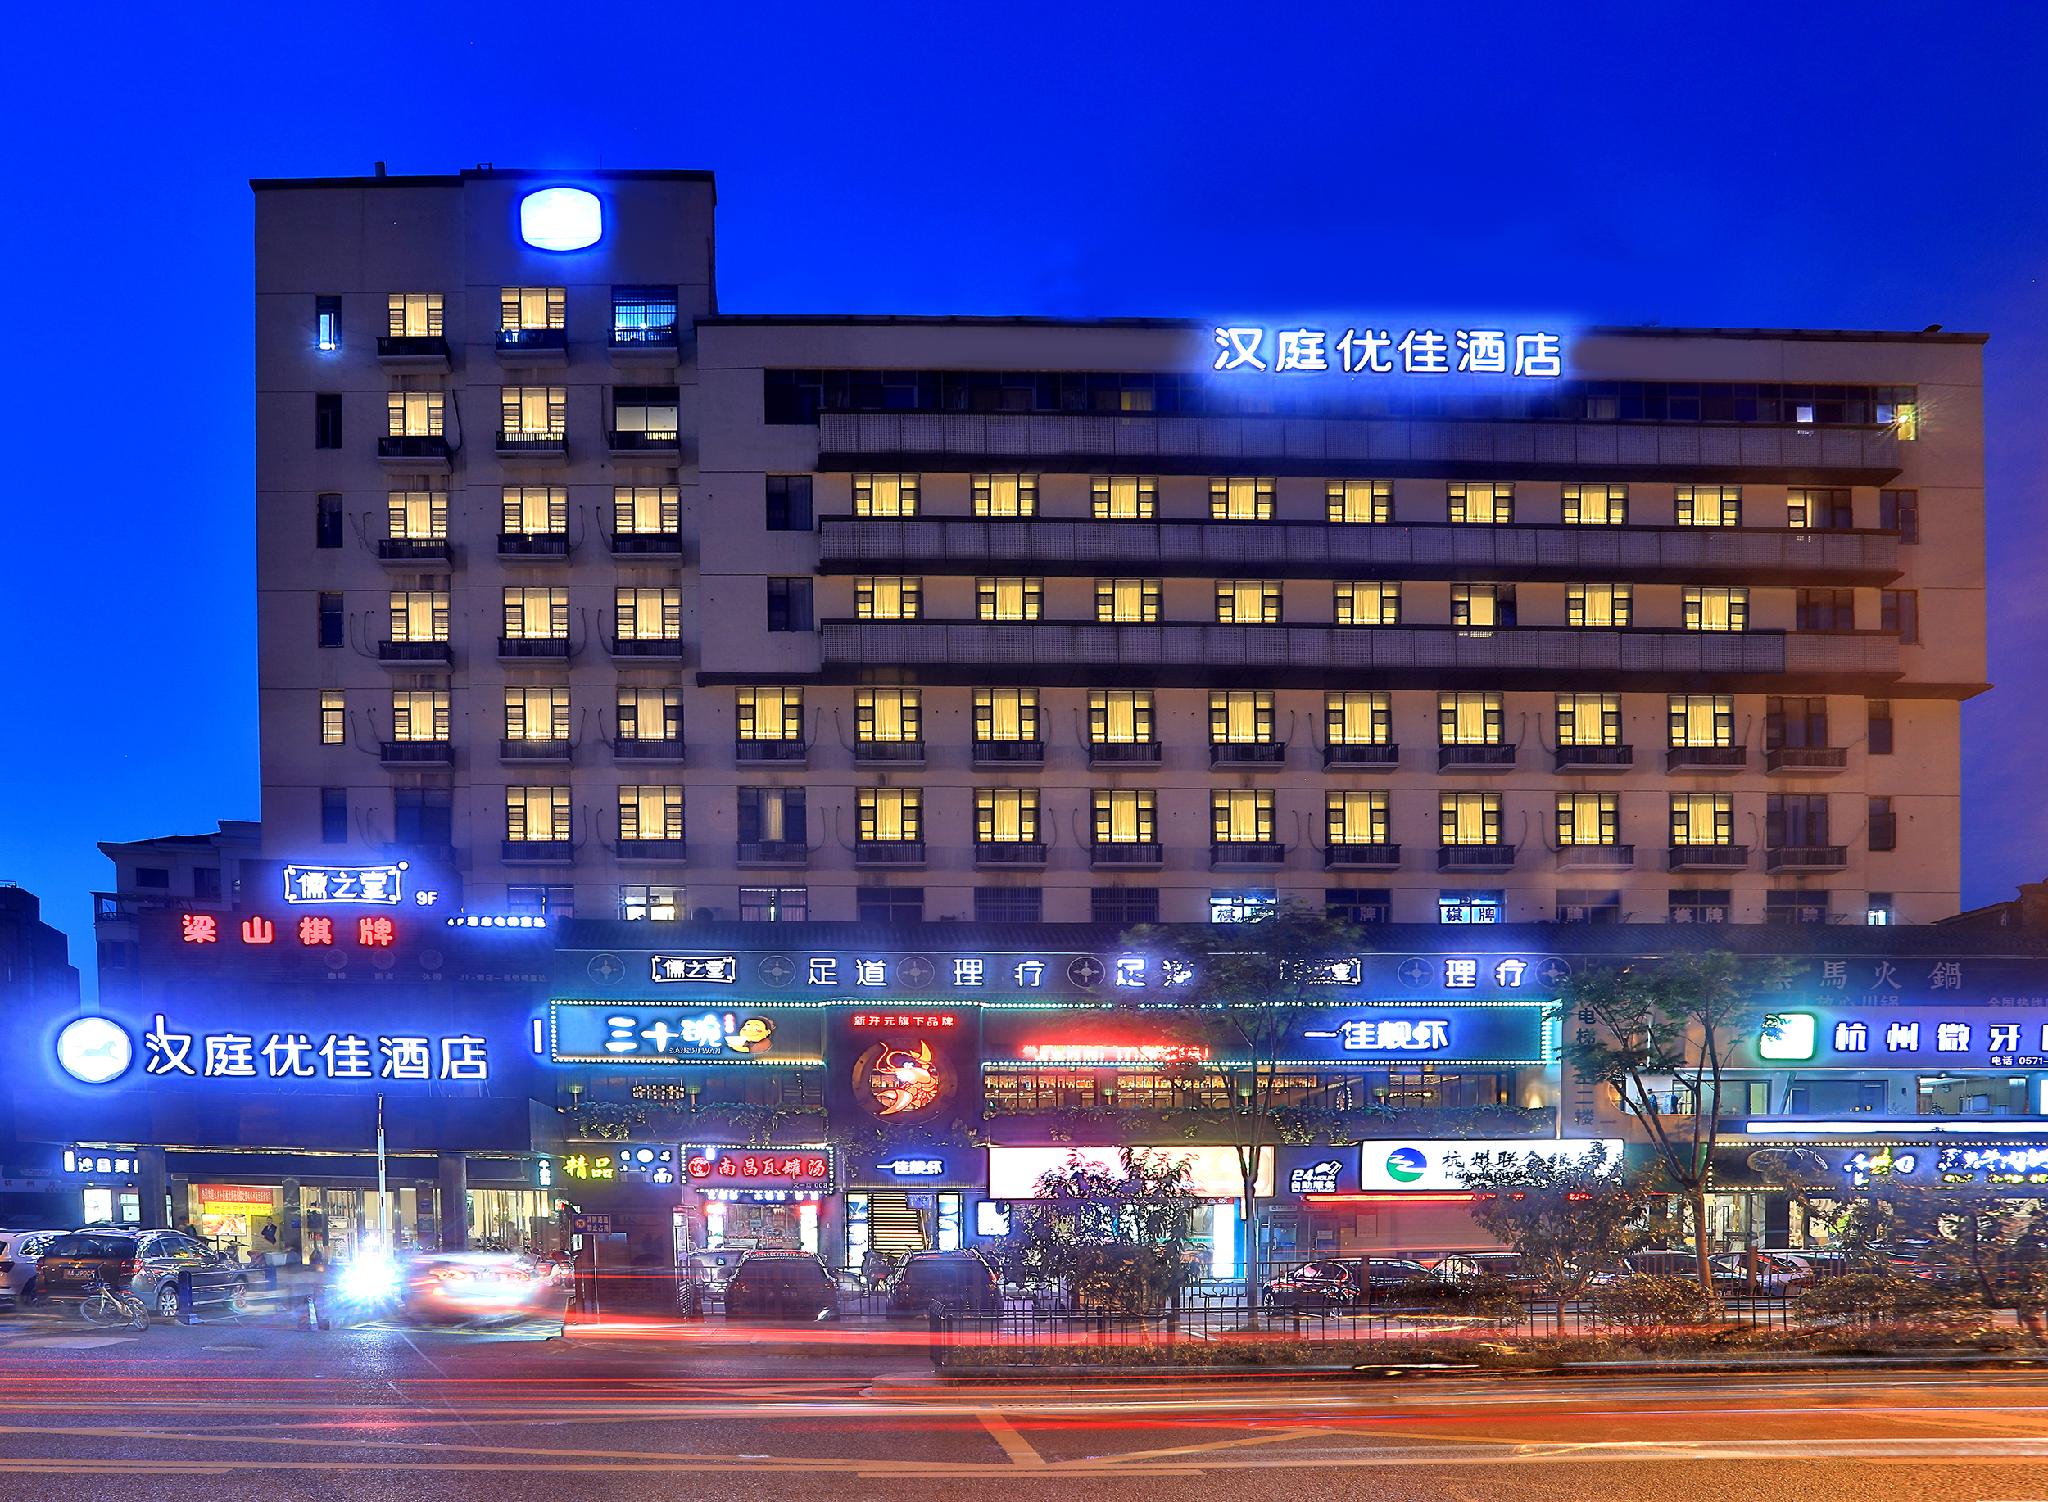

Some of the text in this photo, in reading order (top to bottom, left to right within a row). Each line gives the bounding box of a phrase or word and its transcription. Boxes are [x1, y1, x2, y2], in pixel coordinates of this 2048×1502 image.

[1212, 326, 1562, 377] 汉庭优佳酒店
[416, 891, 438, 906] 9F
[1446, 906, 1495, 922] 棋牌
[182, 914, 393, 946] 梁山棋牌
[1445, 960, 1527, 987] 理疗
[853, 1015, 954, 1026] 新开元旗下品牌
[1835, 1023, 2048, 1051] 杭州微牙
[146, 1034, 487, 1079] 汉庭优佳酒店
[1575, 1007, 1596, 1126] 电梯二楼
[1991, 1056, 2013, 1066] 电话
[718, 1157, 826, 1179] 南昌瓦罐汤
